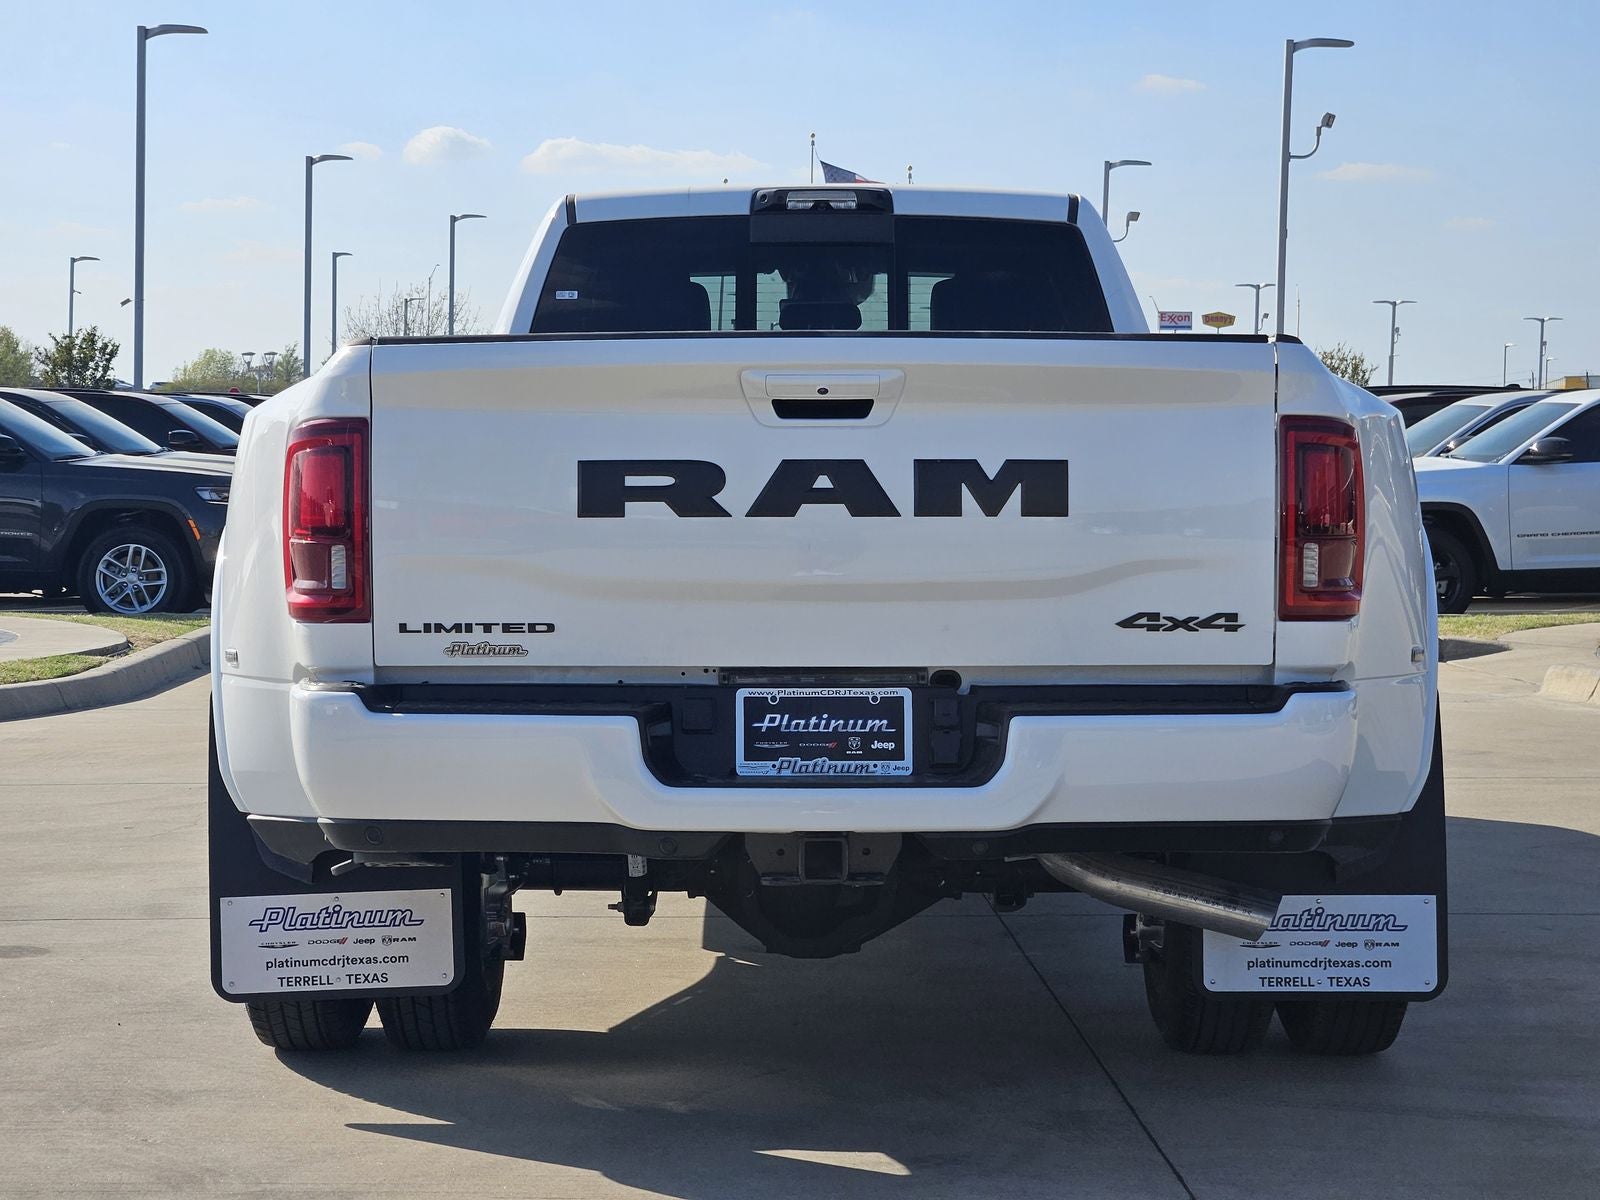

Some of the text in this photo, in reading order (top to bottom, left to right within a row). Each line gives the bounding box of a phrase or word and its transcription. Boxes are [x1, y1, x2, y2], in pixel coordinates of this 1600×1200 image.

[1160, 313, 1190, 324] Exxon
[577, 459, 1069, 518] RAM
[398, 623, 556, 634] LIMITED
[1115, 612, 1246, 632] 4x4
[444, 642, 528, 657] Platinum
[748, 689, 899, 697] www.PlatinumCDRJTexas.com
[752, 714, 896, 732] Platinum
[871, 741, 895, 750] Jeep
[776, 758, 878, 775] Platinum
[893, 765, 910, 773] Jeep
[249, 904, 424, 932] Platinum
[353, 937, 376, 946] Jeep
[266, 954, 409, 971] platinumcdrjtexas.com
[1247, 957, 1392, 970] platinumcdrjtexas.com
[278, 972, 389, 988] TERRELL TEXAS
[1259, 976, 1370, 987] TERRELL TEXAS
